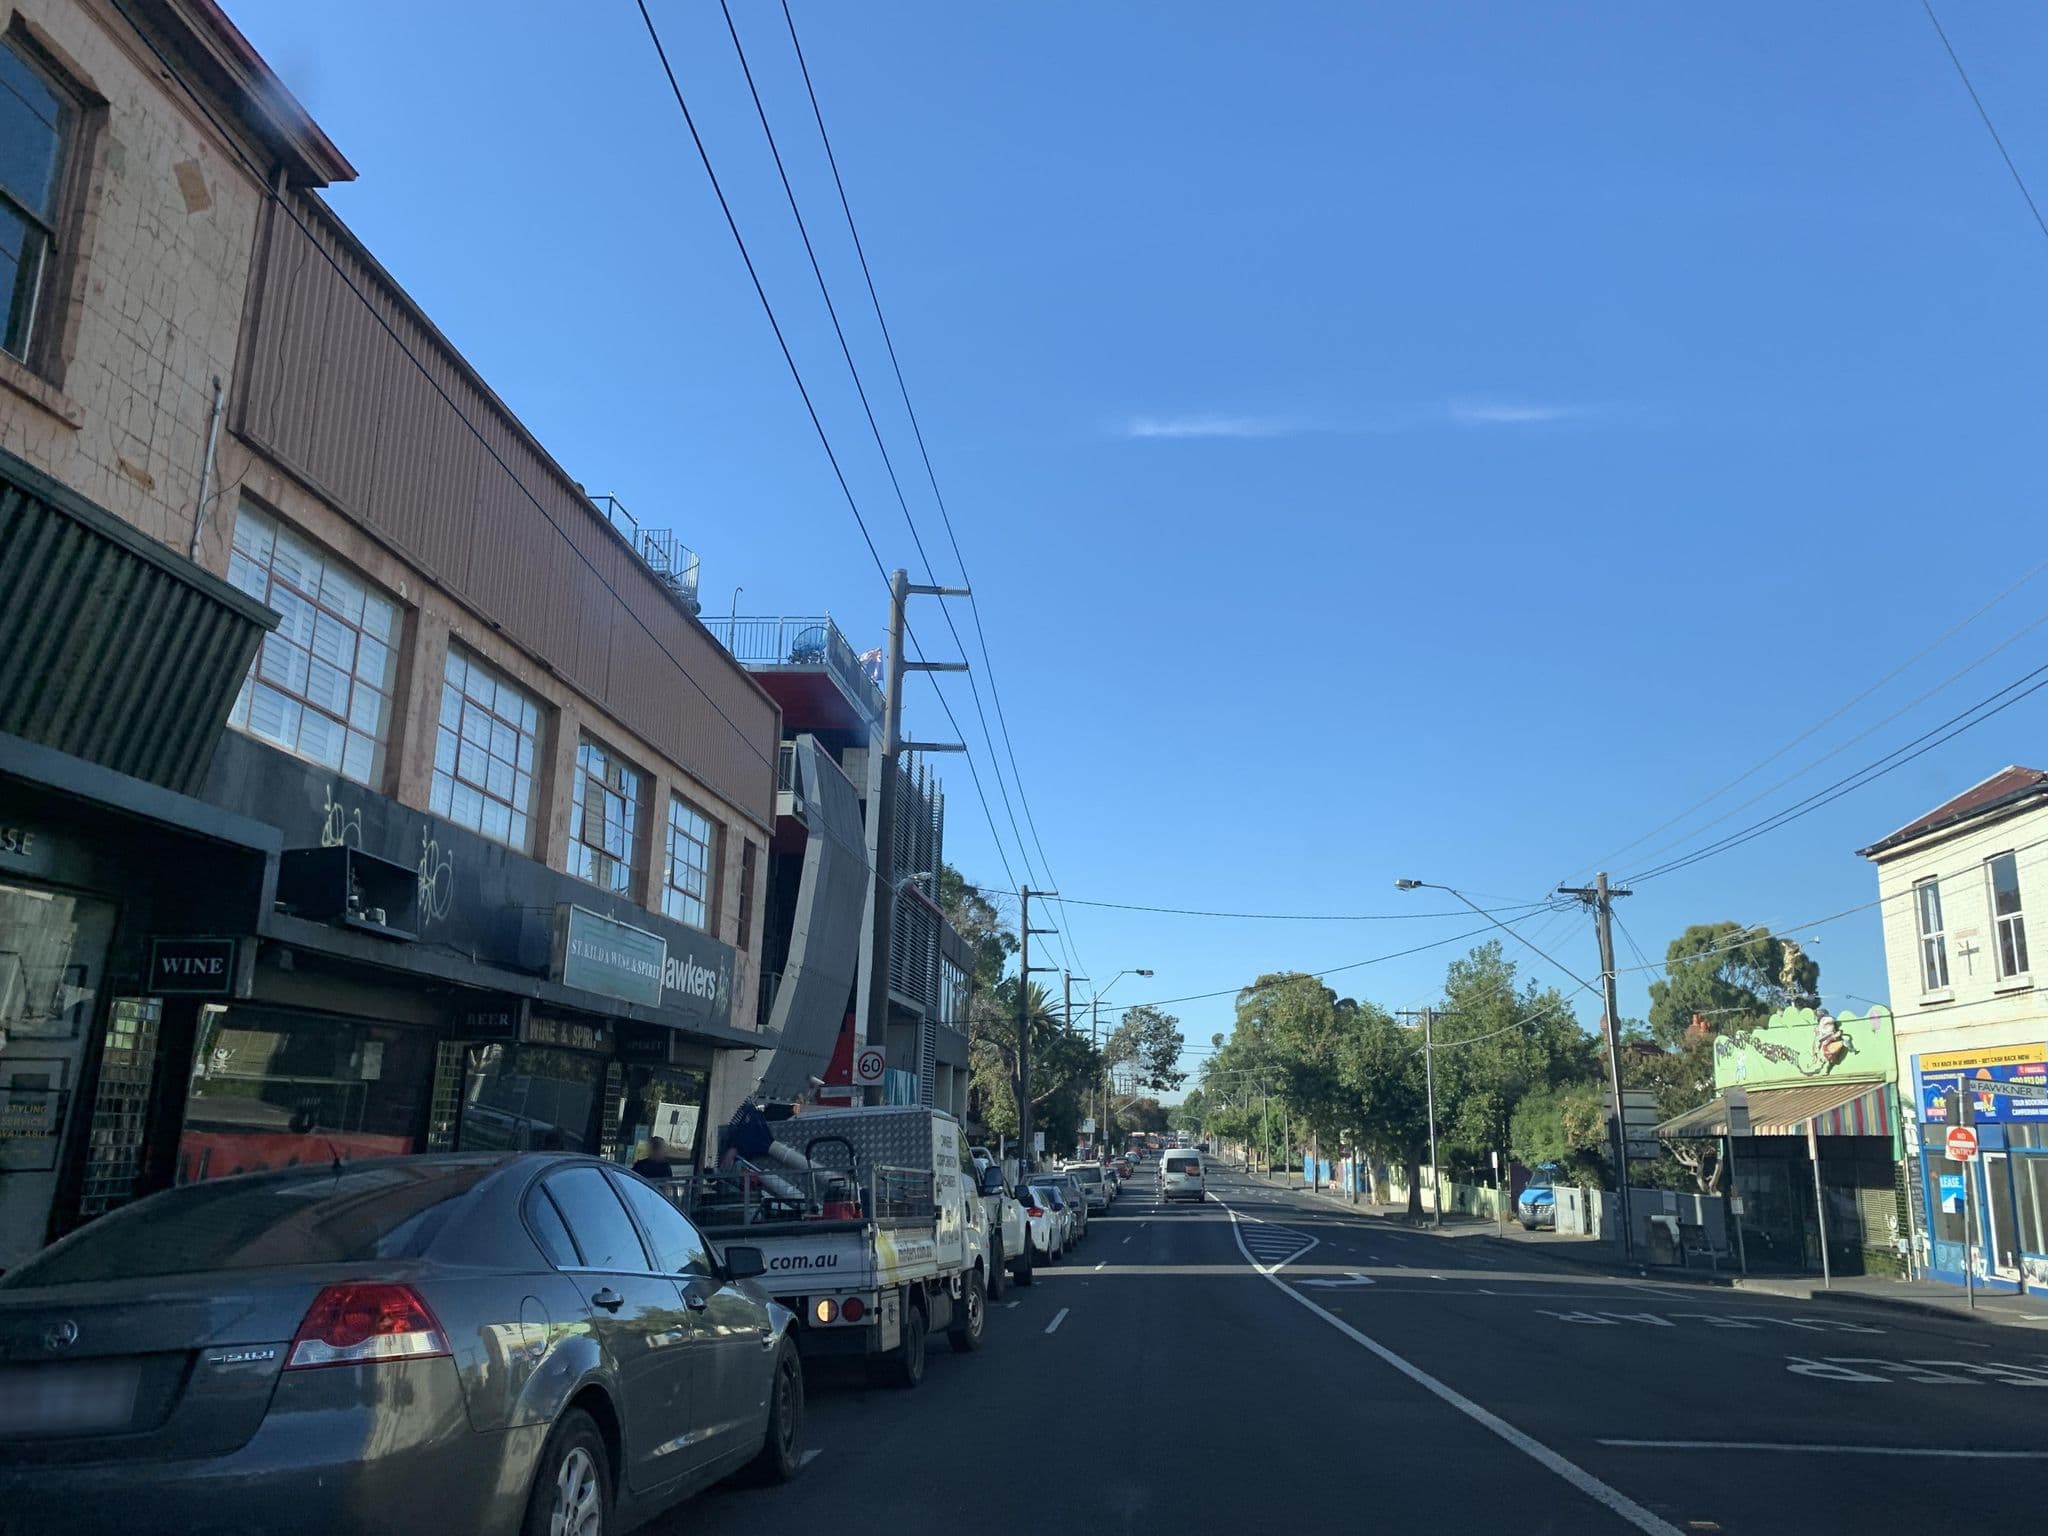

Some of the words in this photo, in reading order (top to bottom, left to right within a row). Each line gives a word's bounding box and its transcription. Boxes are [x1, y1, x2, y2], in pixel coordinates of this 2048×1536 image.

[0, 826, 35, 856] SE
[162, 956, 224, 975] WINE
[637, 960, 661, 980] SPIRIT
[466, 1013, 510, 1026] BEER
[529, 1016, 556, 1043] WINE
[862, 1058, 881, 1073] 60
[1977, 1082, 2034, 1097] FAWKNER
[1956, 1132, 1967, 1140] NO
[770, 1254, 838, 1270] com.au
